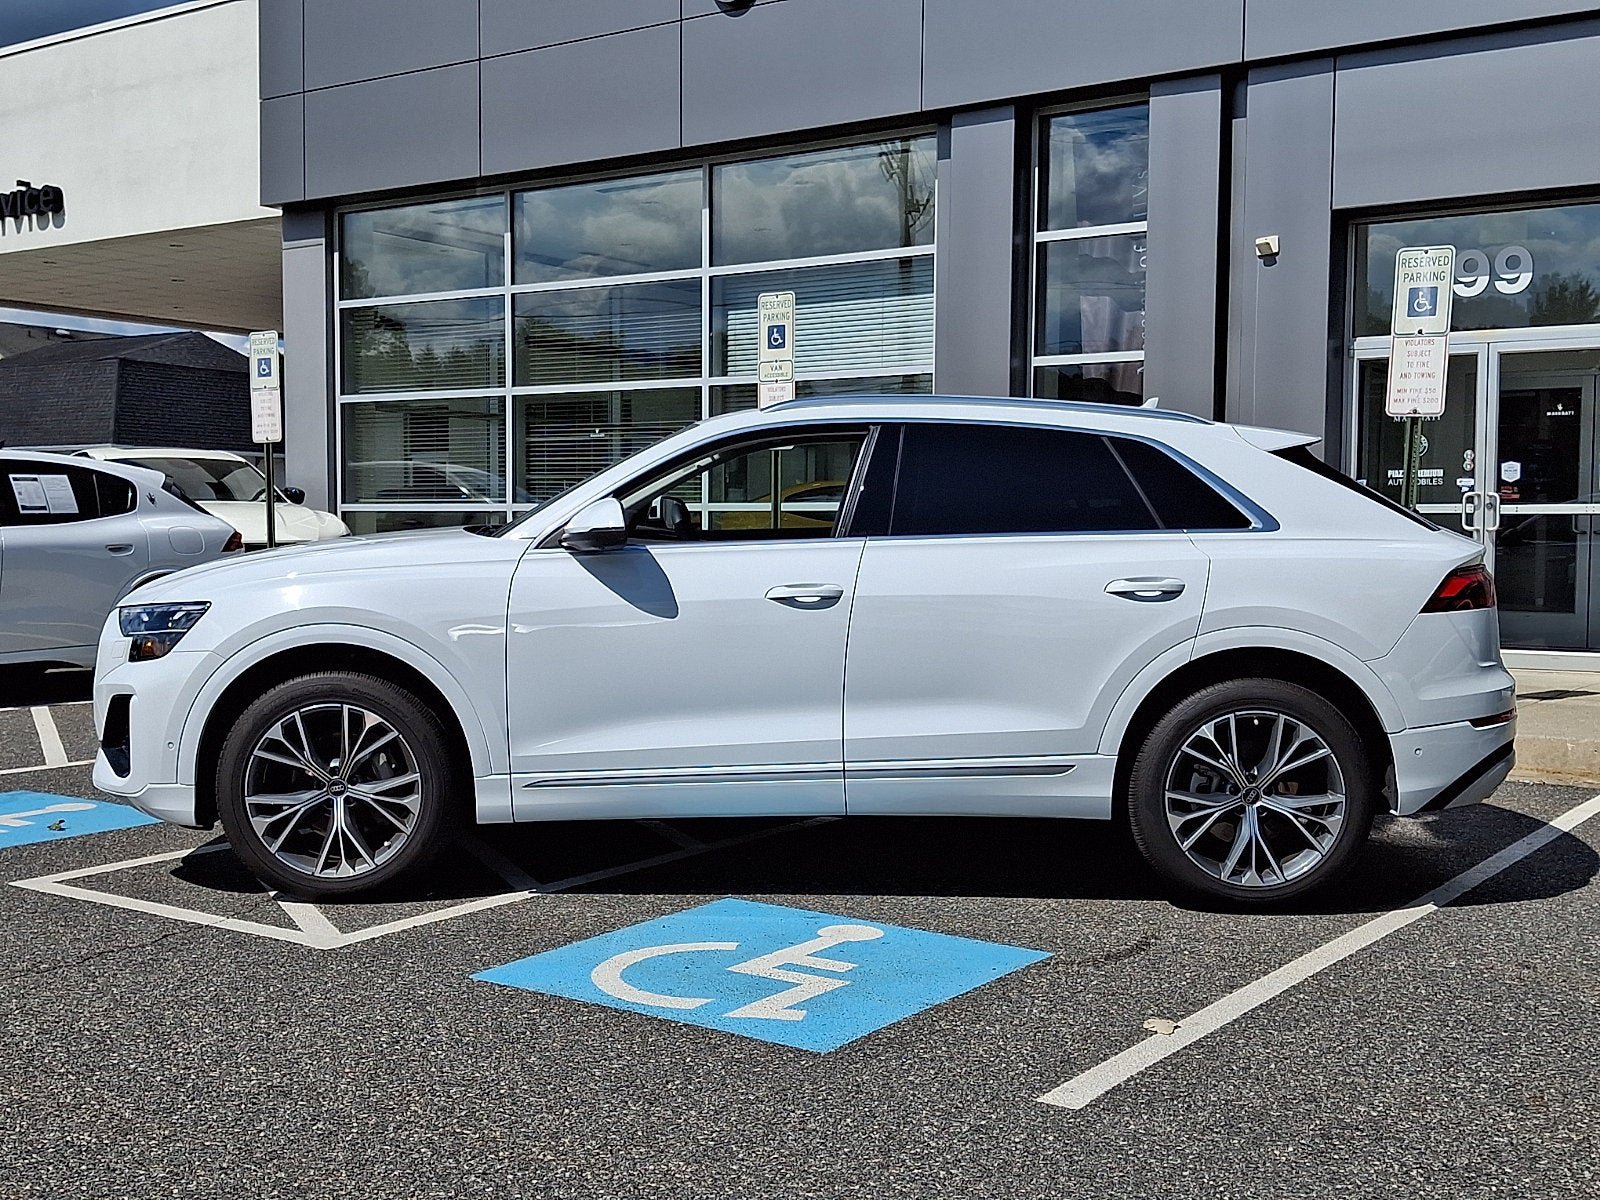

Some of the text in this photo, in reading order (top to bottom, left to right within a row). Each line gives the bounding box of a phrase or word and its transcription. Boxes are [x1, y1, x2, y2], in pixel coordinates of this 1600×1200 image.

[1401, 255, 1450, 269] RESERVED
[1403, 271, 1446, 283] PARKING
[761, 300, 792, 311] RESERVED
[763, 312, 790, 322] PARKING
[251, 338, 275, 346] RESERVED
[1404, 339, 1435, 347] VIOLATORS
[253, 348, 275, 356] PARKING
[1407, 350, 1432, 358] SUBJECT
